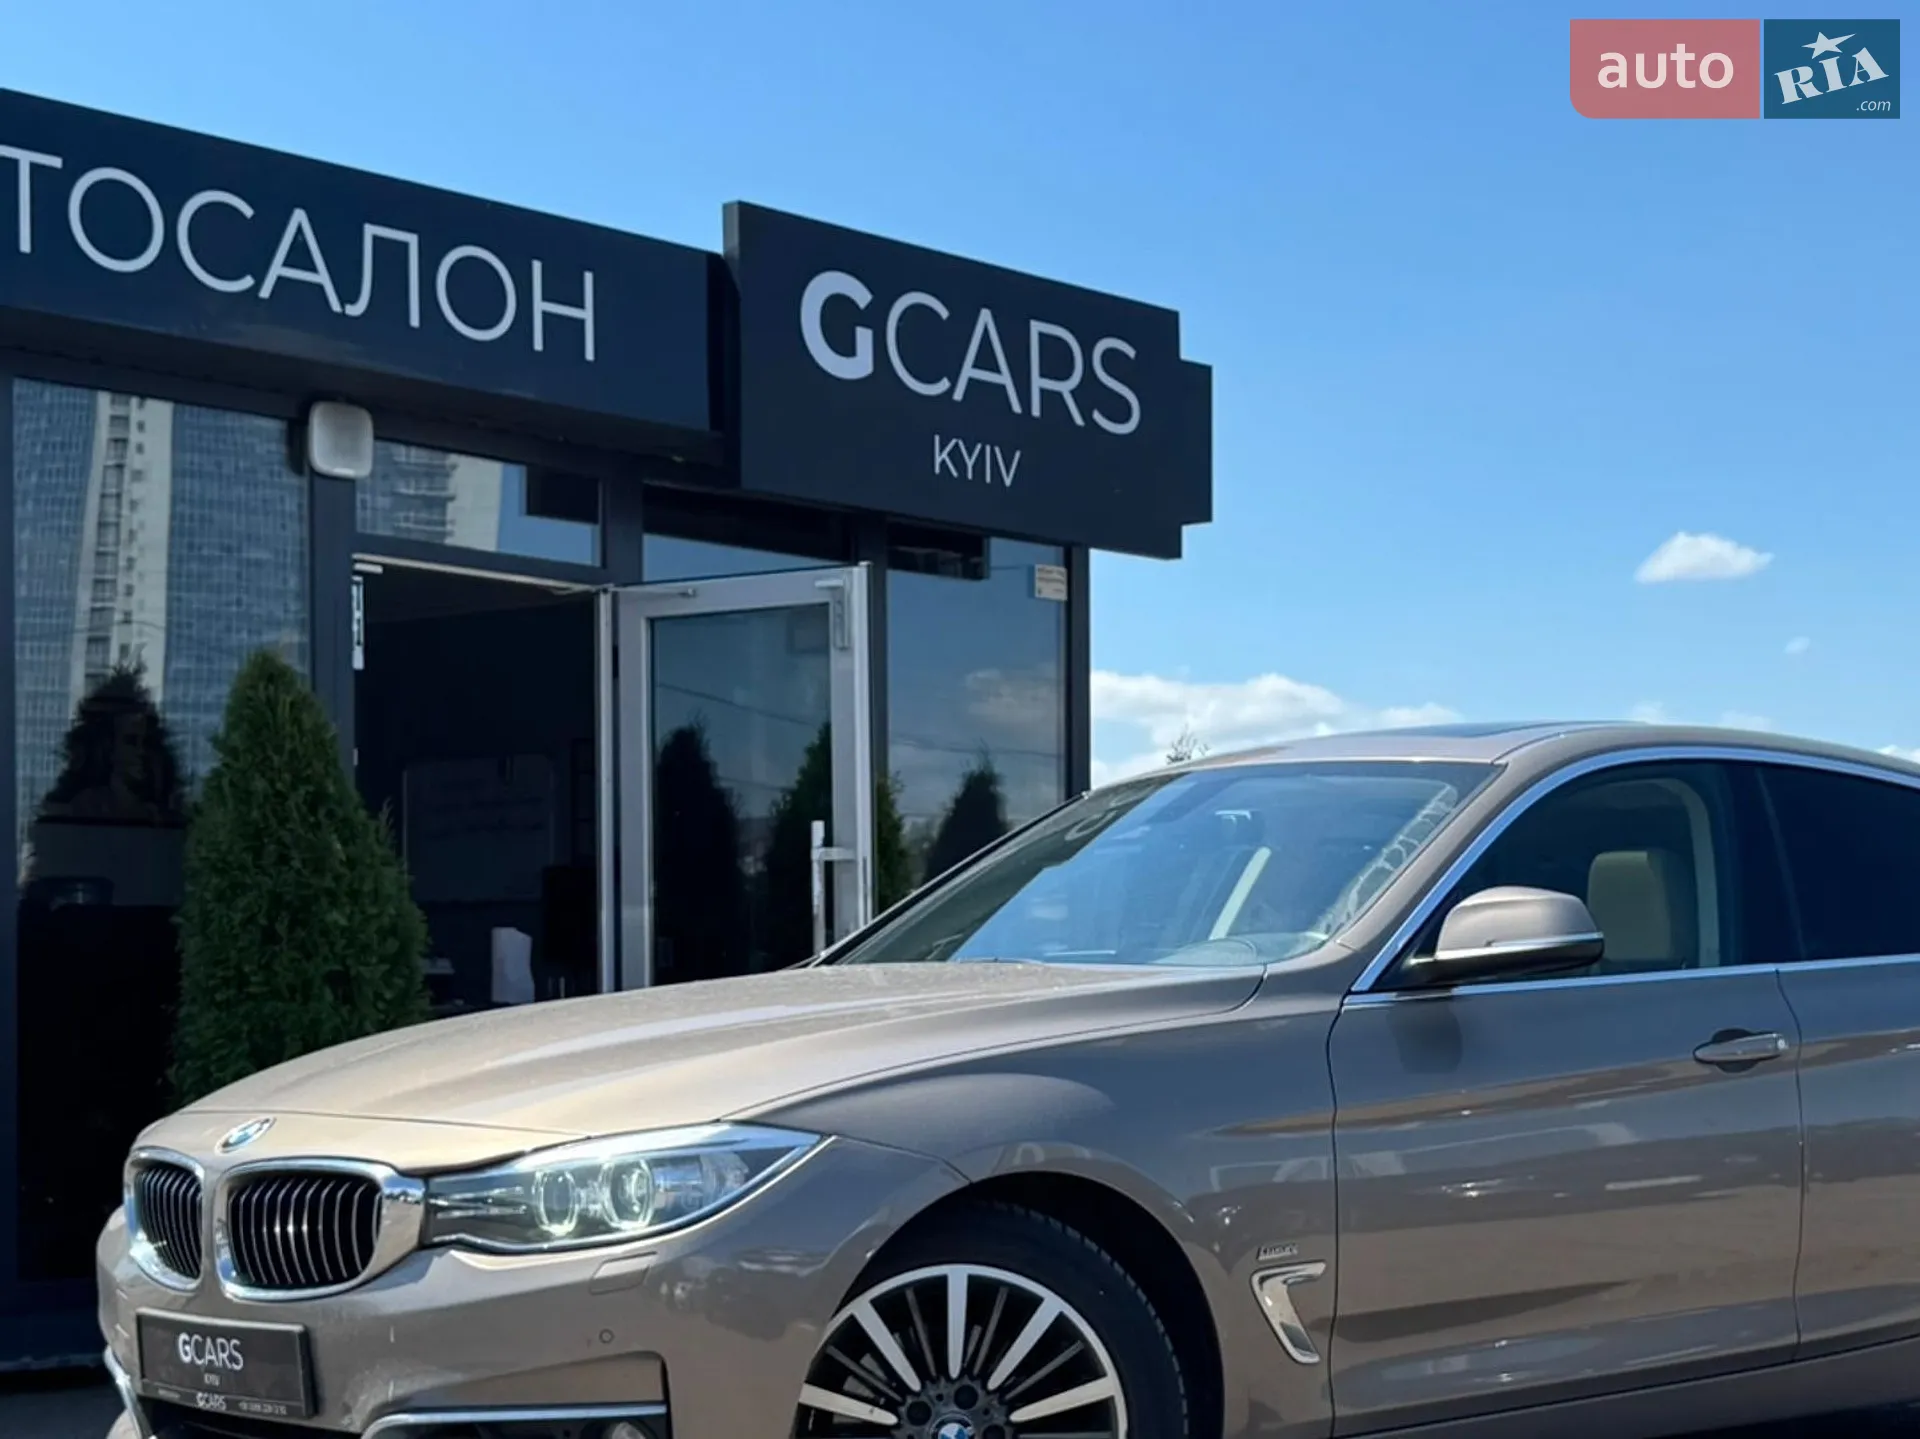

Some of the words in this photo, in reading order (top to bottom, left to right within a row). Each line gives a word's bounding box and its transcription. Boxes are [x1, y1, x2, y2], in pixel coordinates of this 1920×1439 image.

[0, 144, 595, 361] ТОСАЛОН
[799, 270, 1142, 435] GCARS
[933, 433, 1022, 488] KYIV
[178, 1332, 244, 1371] GCARS
